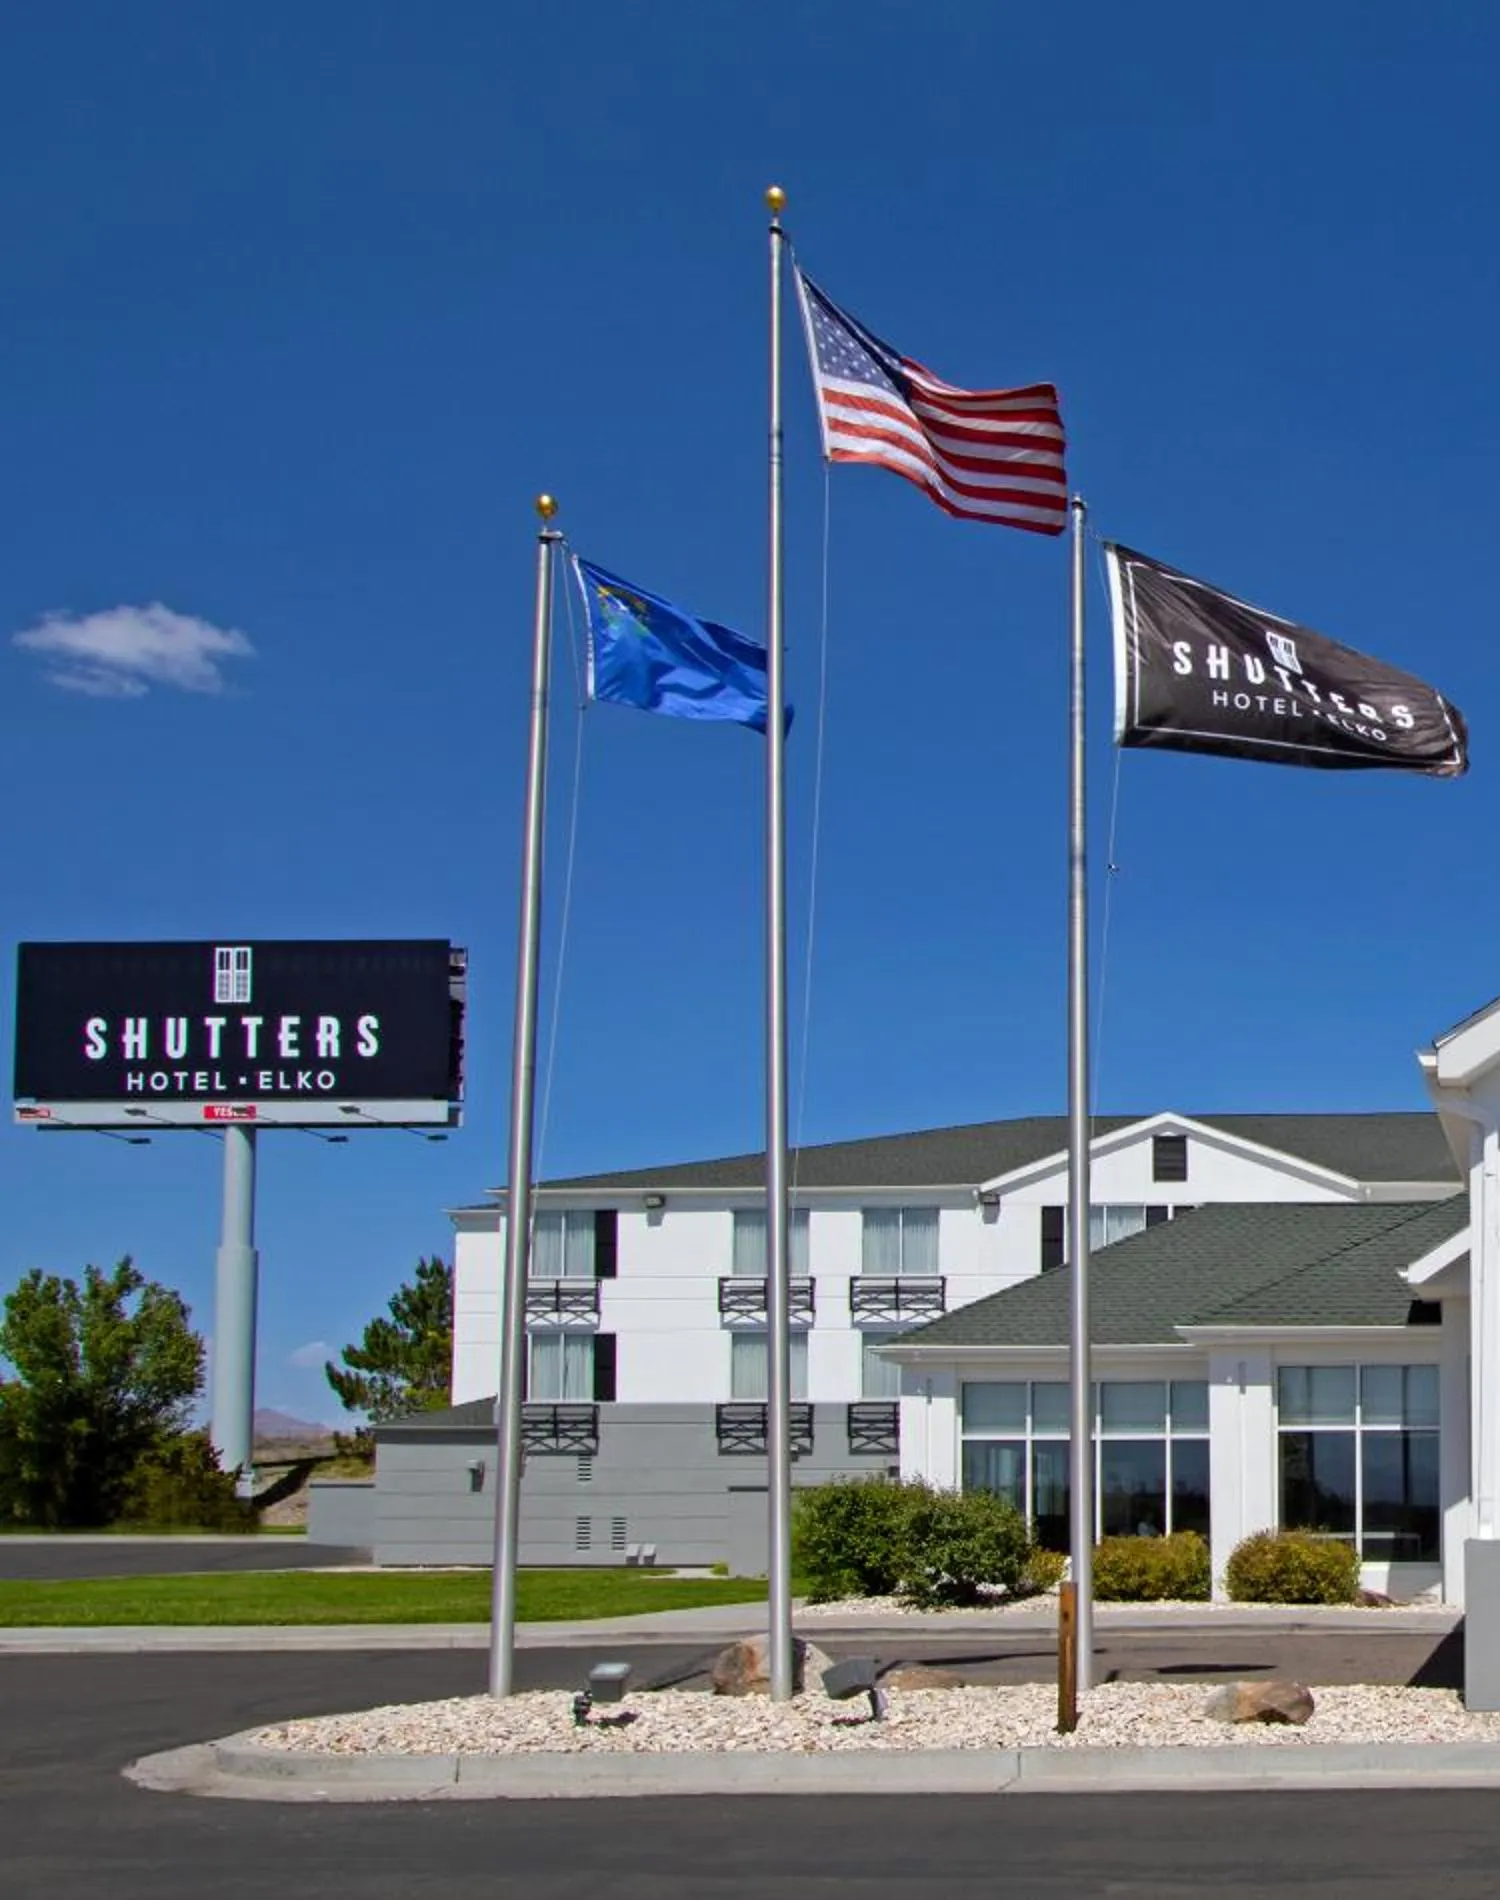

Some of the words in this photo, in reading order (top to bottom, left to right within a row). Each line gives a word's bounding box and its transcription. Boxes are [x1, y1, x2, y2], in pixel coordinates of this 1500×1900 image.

[1172, 641, 1415, 729] SHUTTERS
[1213, 690, 1303, 718] HOTEL
[85, 1014, 380, 1060] SHUTTERS
[126, 1071, 227, 1091] HOTEL
[258, 1070, 336, 1090] ELKO
